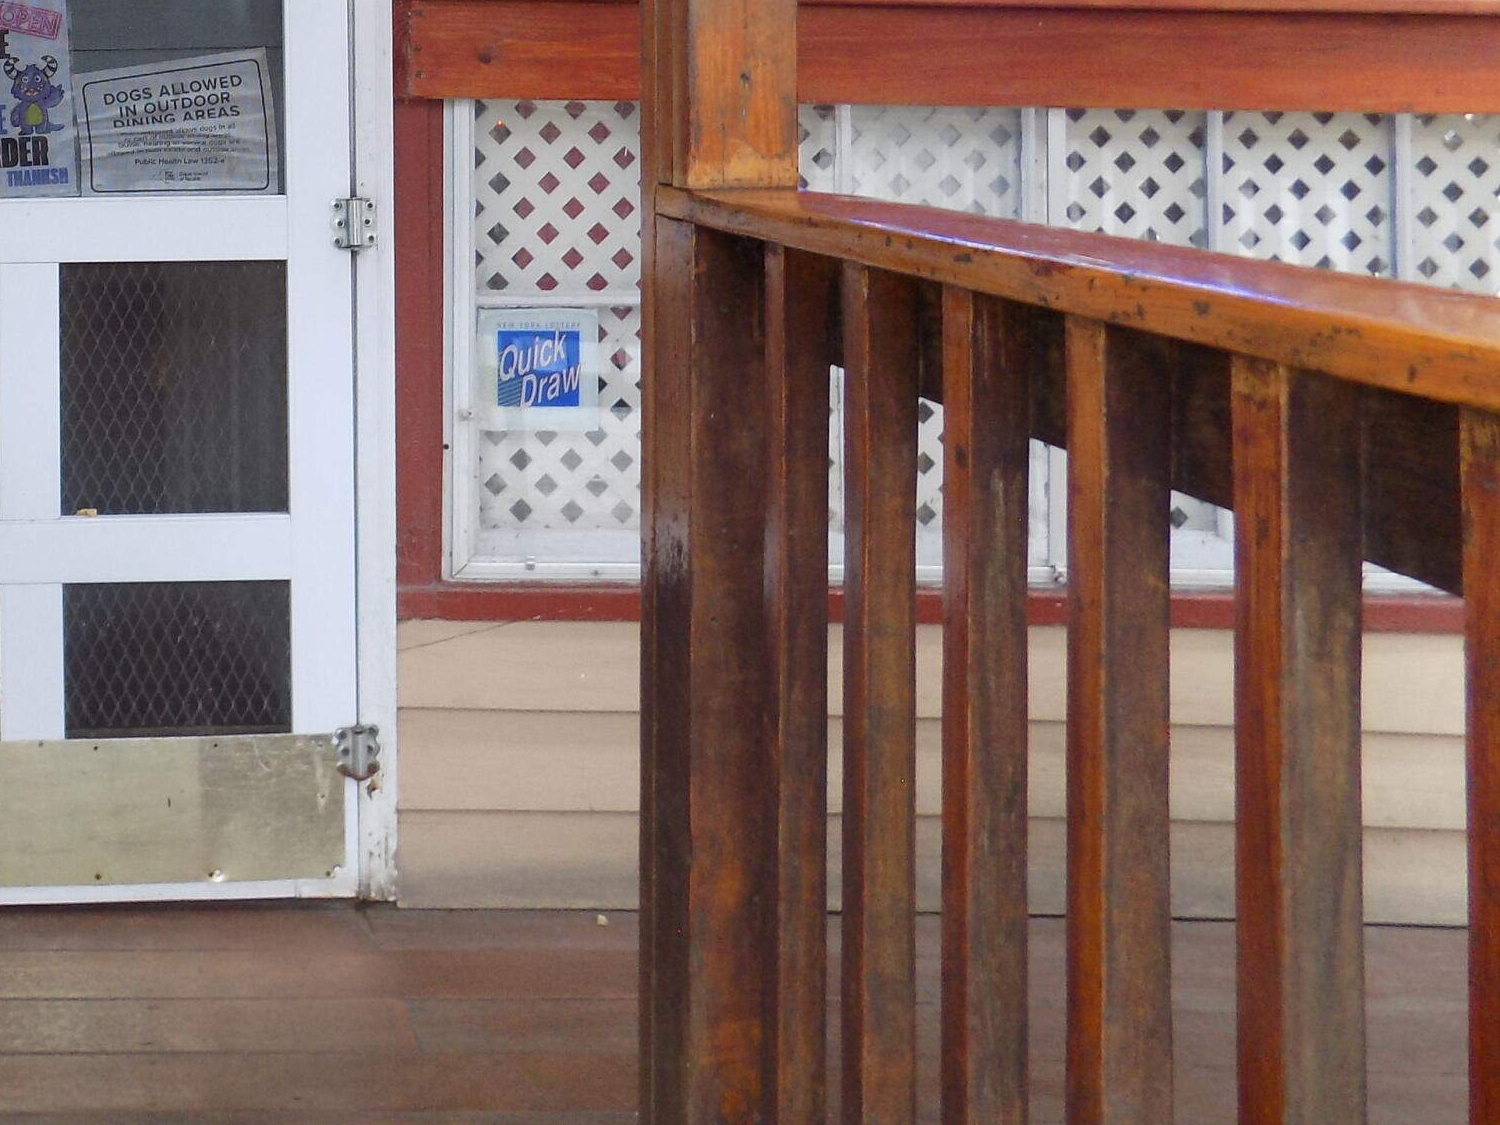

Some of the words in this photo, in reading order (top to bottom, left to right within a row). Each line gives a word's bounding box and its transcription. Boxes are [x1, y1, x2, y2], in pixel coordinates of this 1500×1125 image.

[2, 8, 56, 32] OPEN
[103, 87, 153, 106] DOGS
[159, 75, 242, 97] ALLOWED
[113, 113, 176, 128] DINING
[183, 106, 240, 122] AREAS
[119, 104, 137, 118] IN
[144, 92, 230, 114] OUTDOOR
[158, 157, 182, 165] Health
[499, 329, 566, 381] Quick
[520, 363, 581, 410] Draw
